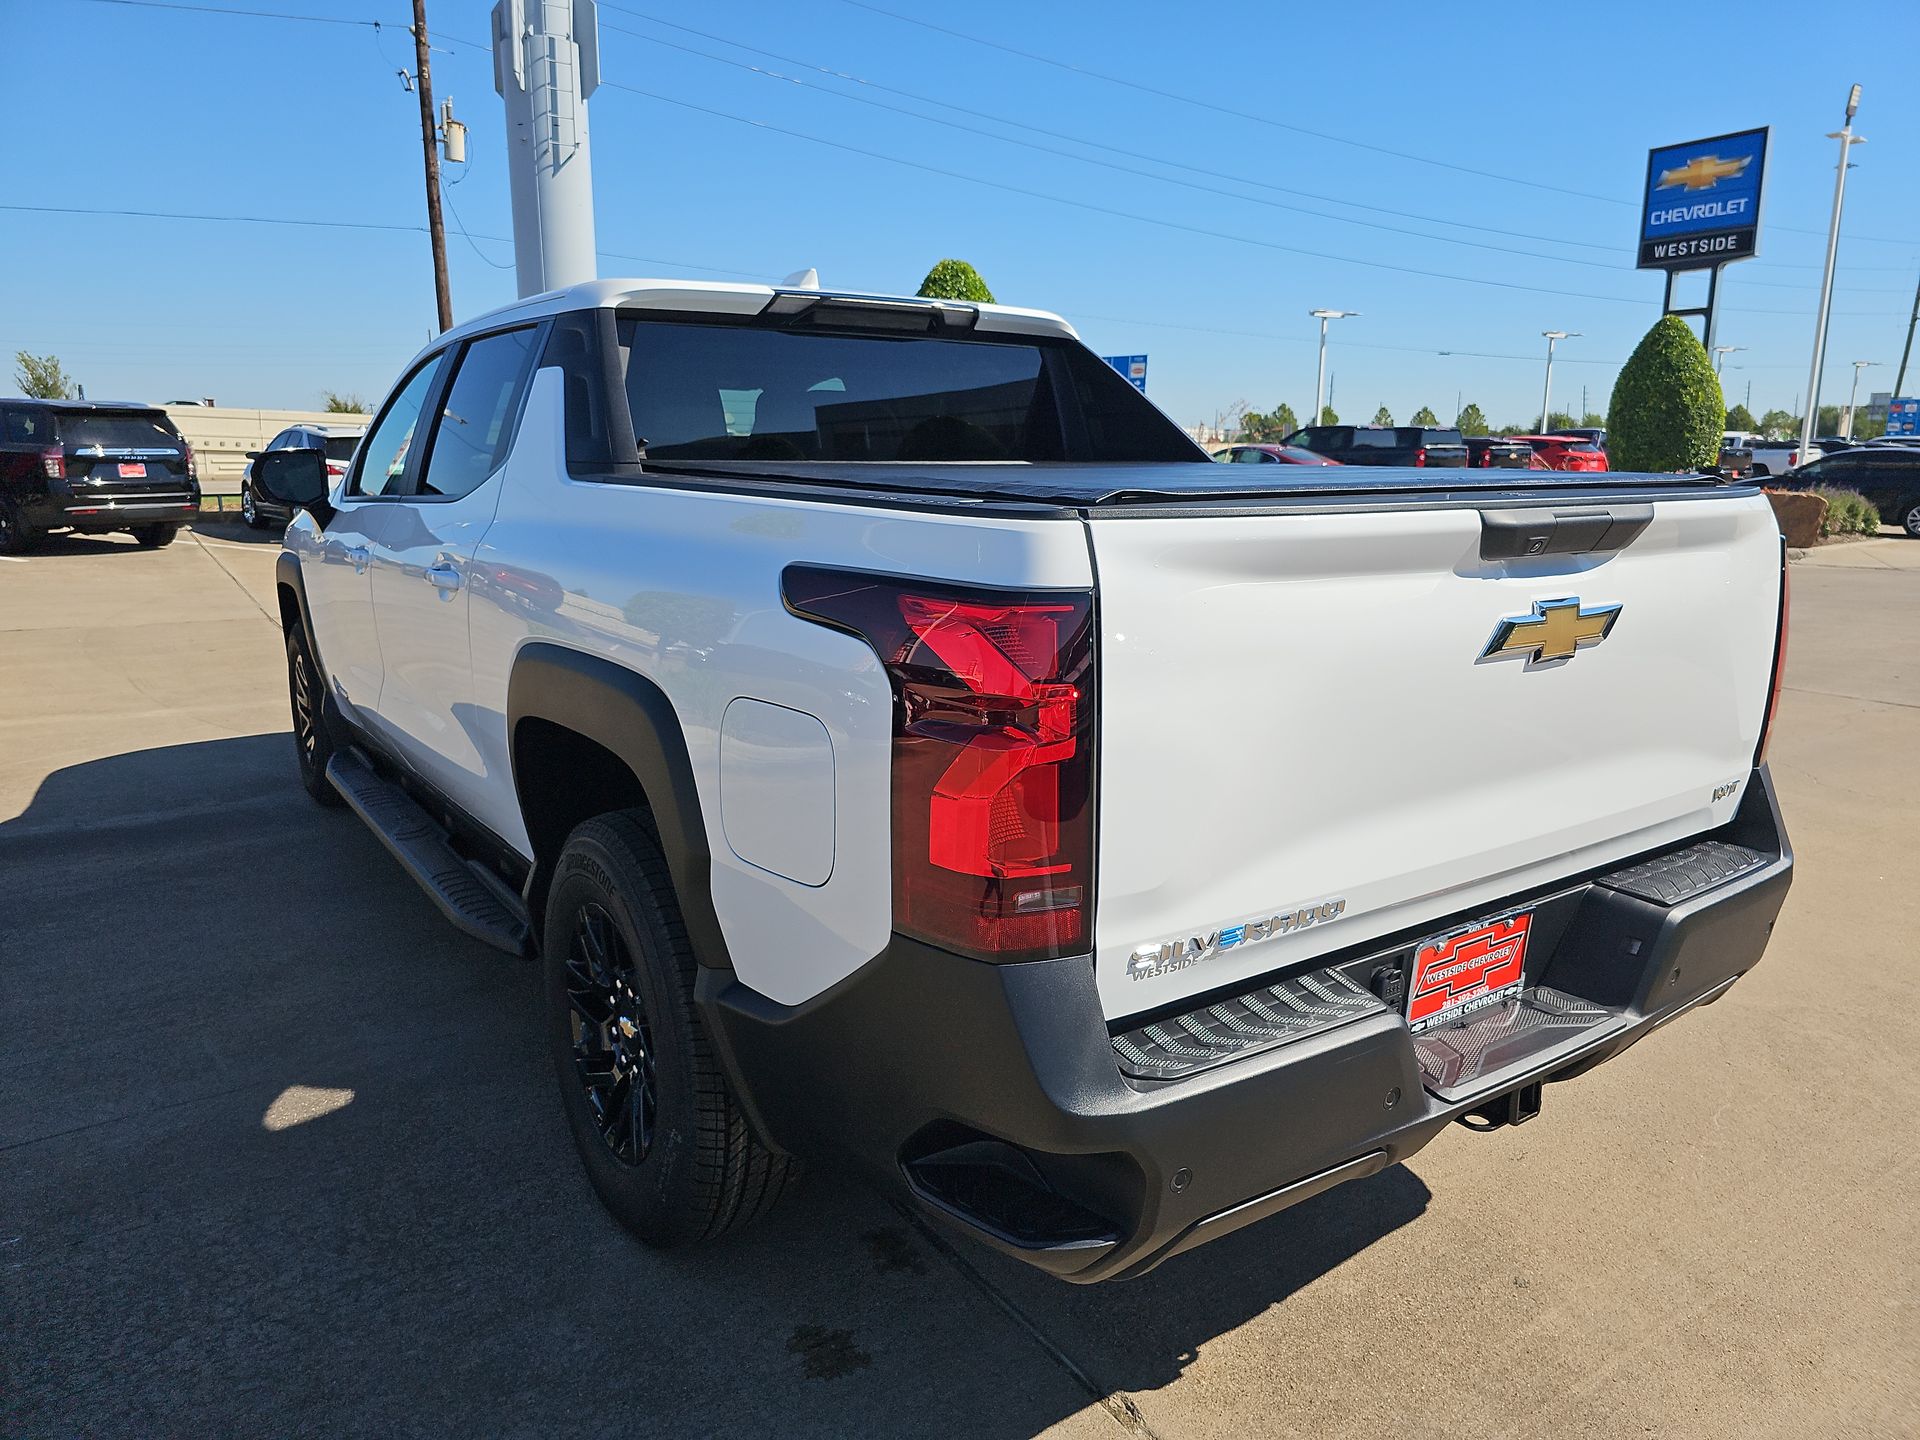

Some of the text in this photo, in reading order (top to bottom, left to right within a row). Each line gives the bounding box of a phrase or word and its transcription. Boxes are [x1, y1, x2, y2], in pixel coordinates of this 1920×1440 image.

[1651, 198, 1748, 225] CHEVROLET
[1654, 235, 1738, 258] WESTSIDE
[1126, 898, 1346, 973] SILVERADO
[1132, 957, 1199, 982] WESTSIDE
[1426, 946, 1512, 984] WESTSIDE CHEVROLET
[1426, 990, 1506, 1028] WESTSIDE CHEVROLET
